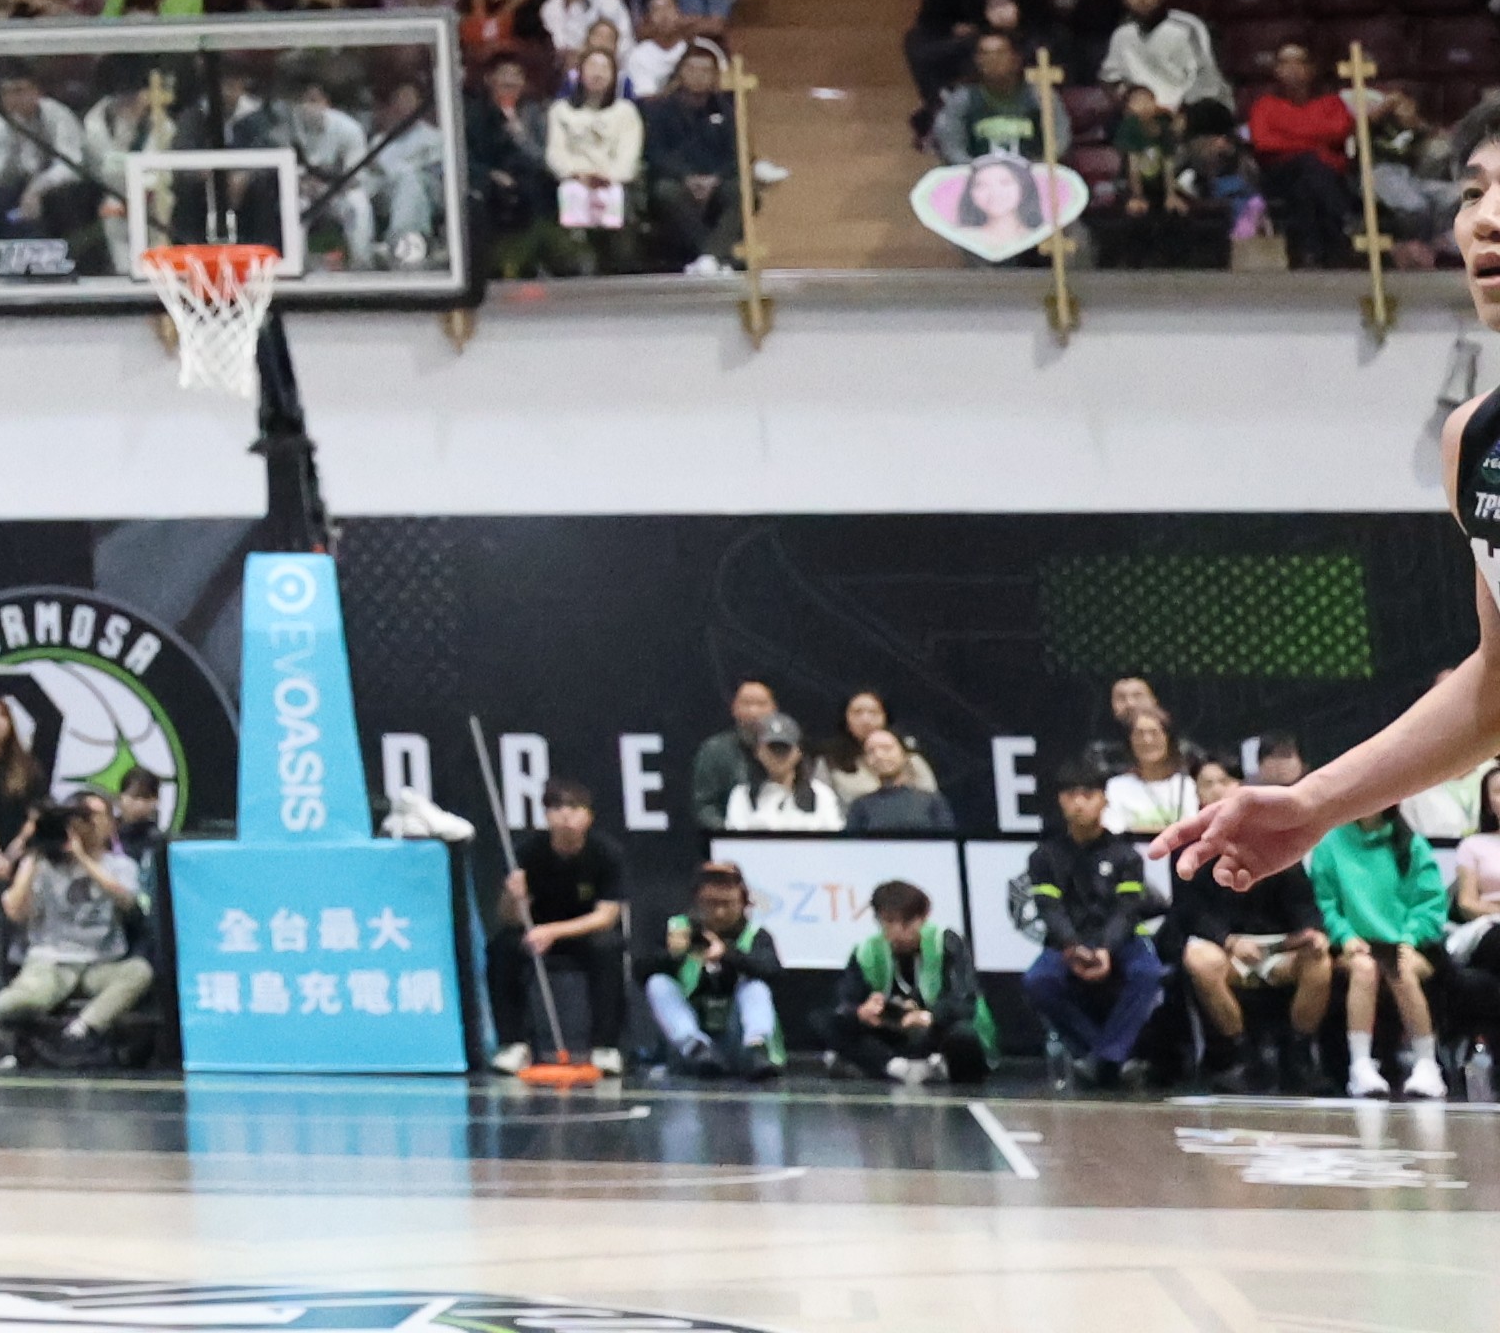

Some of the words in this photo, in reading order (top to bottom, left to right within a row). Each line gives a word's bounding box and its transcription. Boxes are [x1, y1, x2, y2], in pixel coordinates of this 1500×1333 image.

[269, 619, 328, 832] EVOASIS
[217, 906, 412, 953] 全台最大
